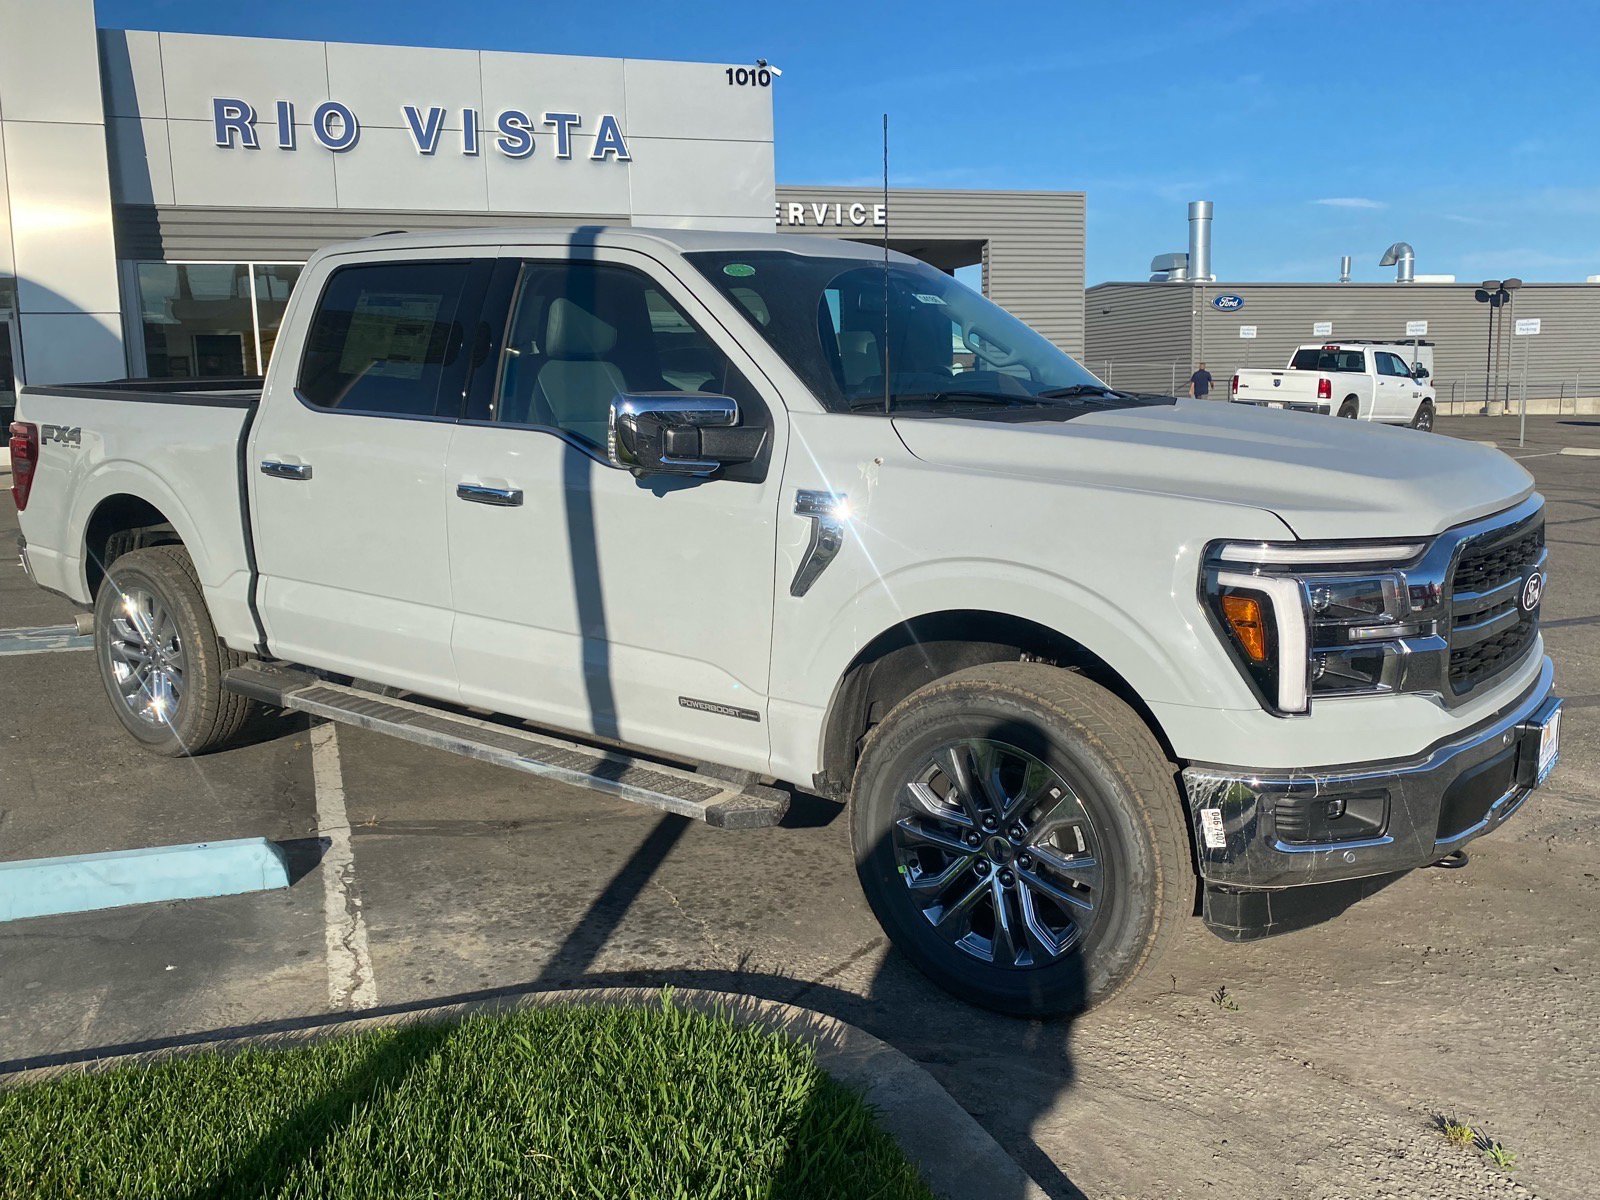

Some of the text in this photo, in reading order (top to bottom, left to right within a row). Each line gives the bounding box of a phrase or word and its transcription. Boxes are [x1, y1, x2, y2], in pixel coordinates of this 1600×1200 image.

[726, 68, 771, 87] 1010
[212, 97, 632, 161] RIO VISTA
[41, 424, 81, 445] FX4
[680, 698, 740, 717] POWERBOOST
[1211, 811, 1222, 826] 046
